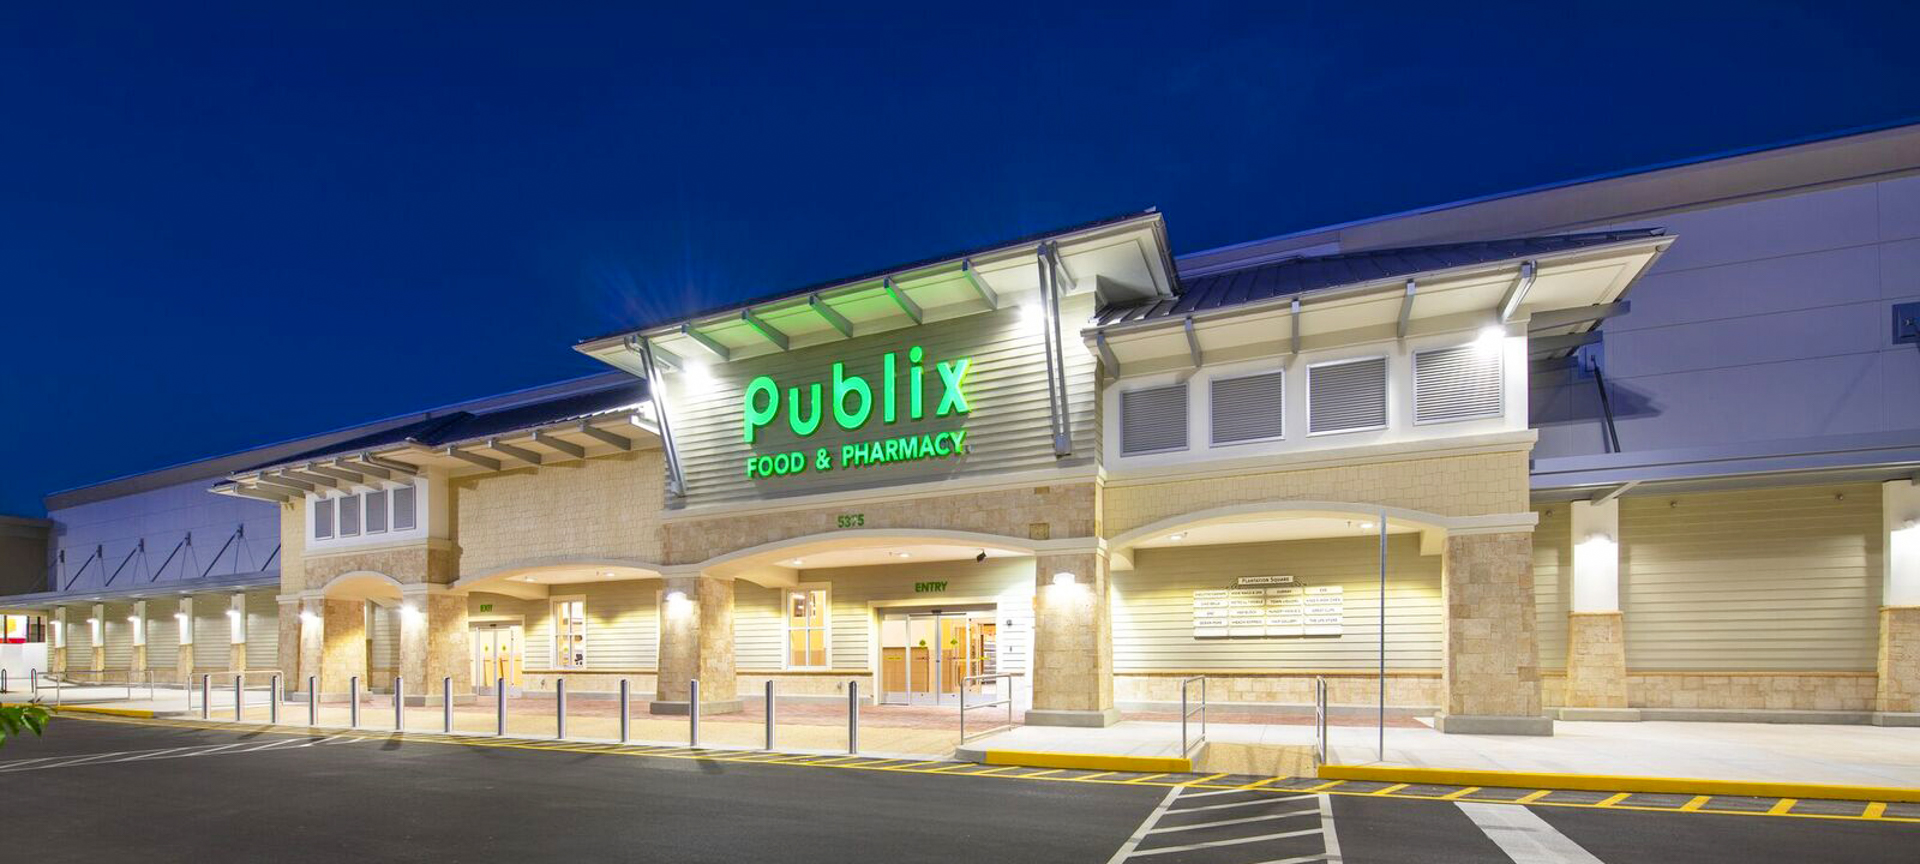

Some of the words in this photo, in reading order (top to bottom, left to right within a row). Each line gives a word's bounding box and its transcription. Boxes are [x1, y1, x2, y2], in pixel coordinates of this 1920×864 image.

[743, 345, 974, 444] Publix
[748, 452, 806, 478] FOOD
[815, 448, 833, 470] &
[841, 430, 967, 467] PHARMACY
[837, 513, 865, 528] 5375
[915, 580, 948, 593] ENTRY
[480, 604, 493, 613] EXIT
